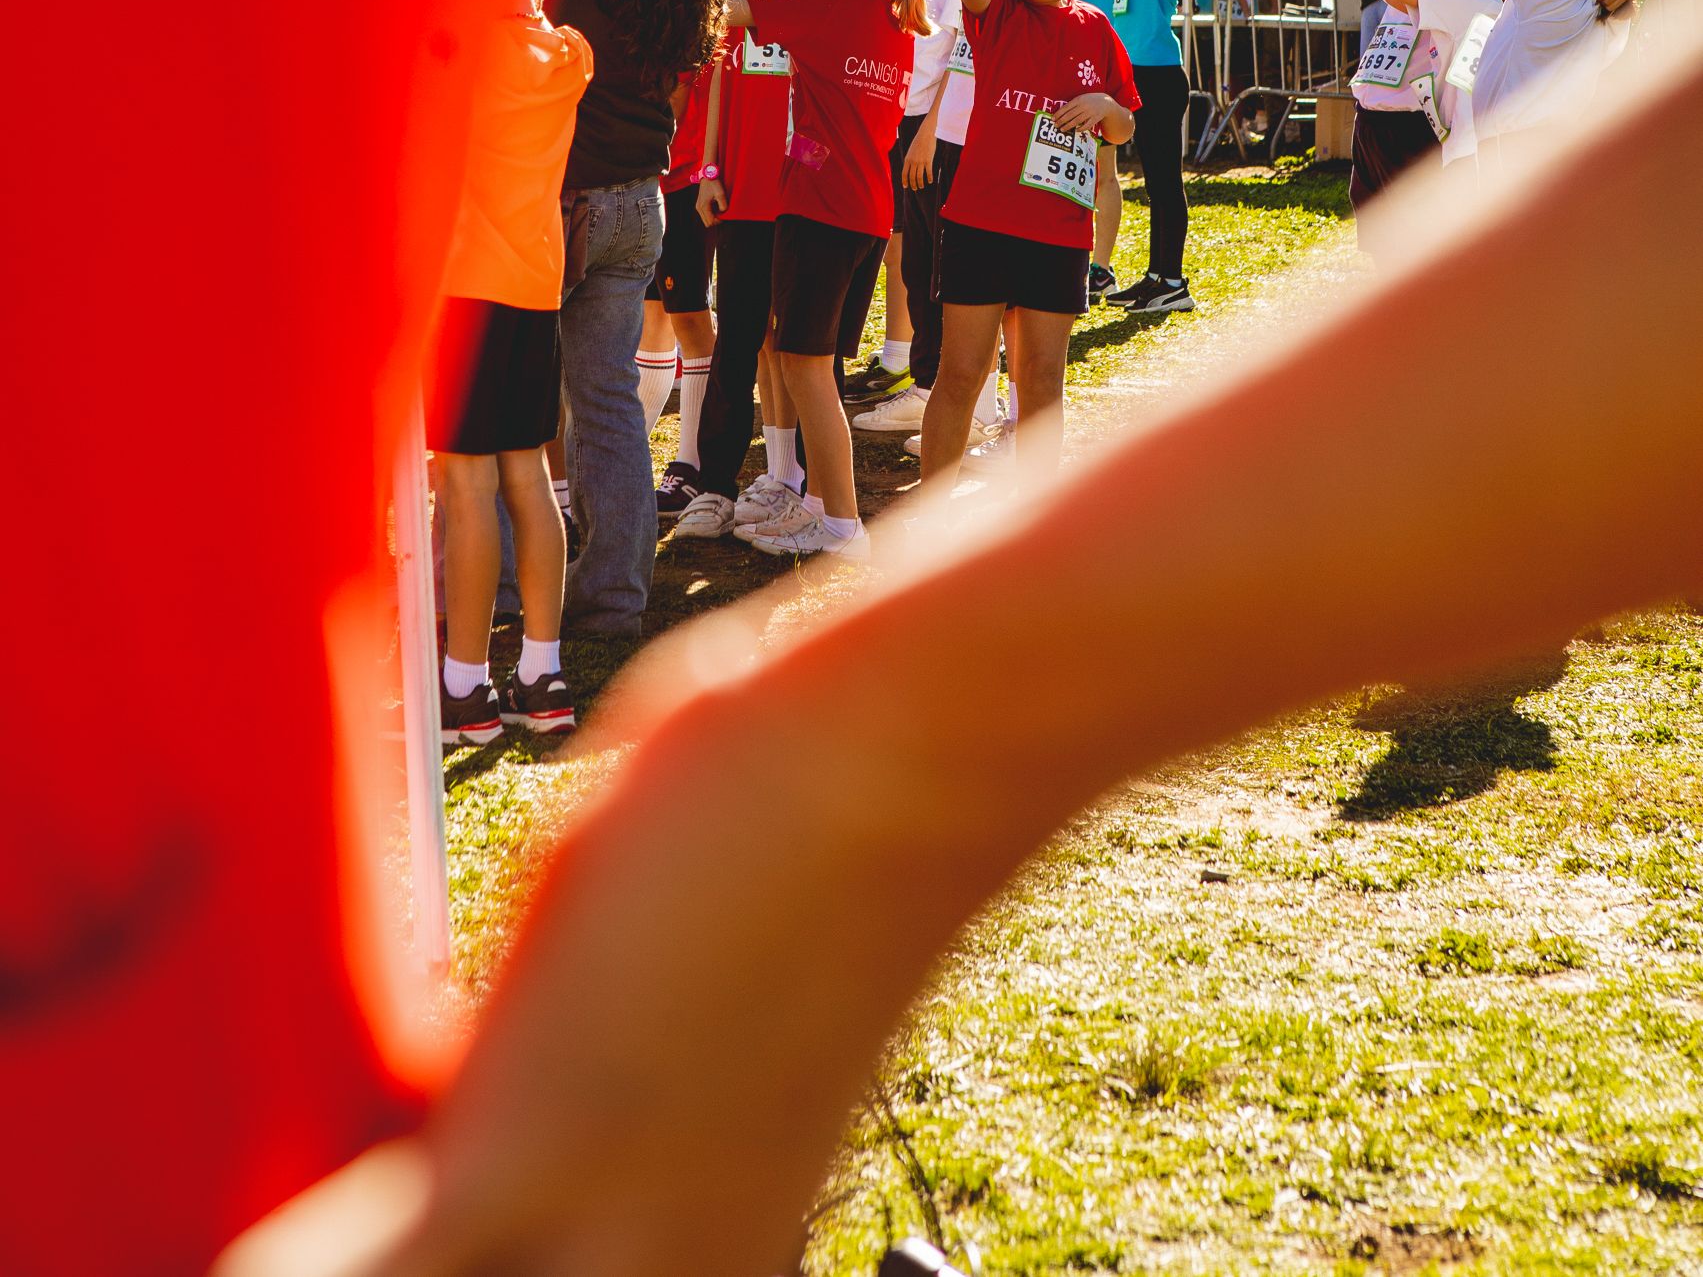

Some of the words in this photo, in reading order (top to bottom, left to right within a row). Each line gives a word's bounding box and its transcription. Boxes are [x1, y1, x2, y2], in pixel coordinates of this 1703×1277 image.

[844, 56, 899, 85] CANIGÓ
[869, 82, 895, 96] FOMENTO
[1040, 127, 1073, 148] CROS
[1047, 155, 1088, 187] 586
